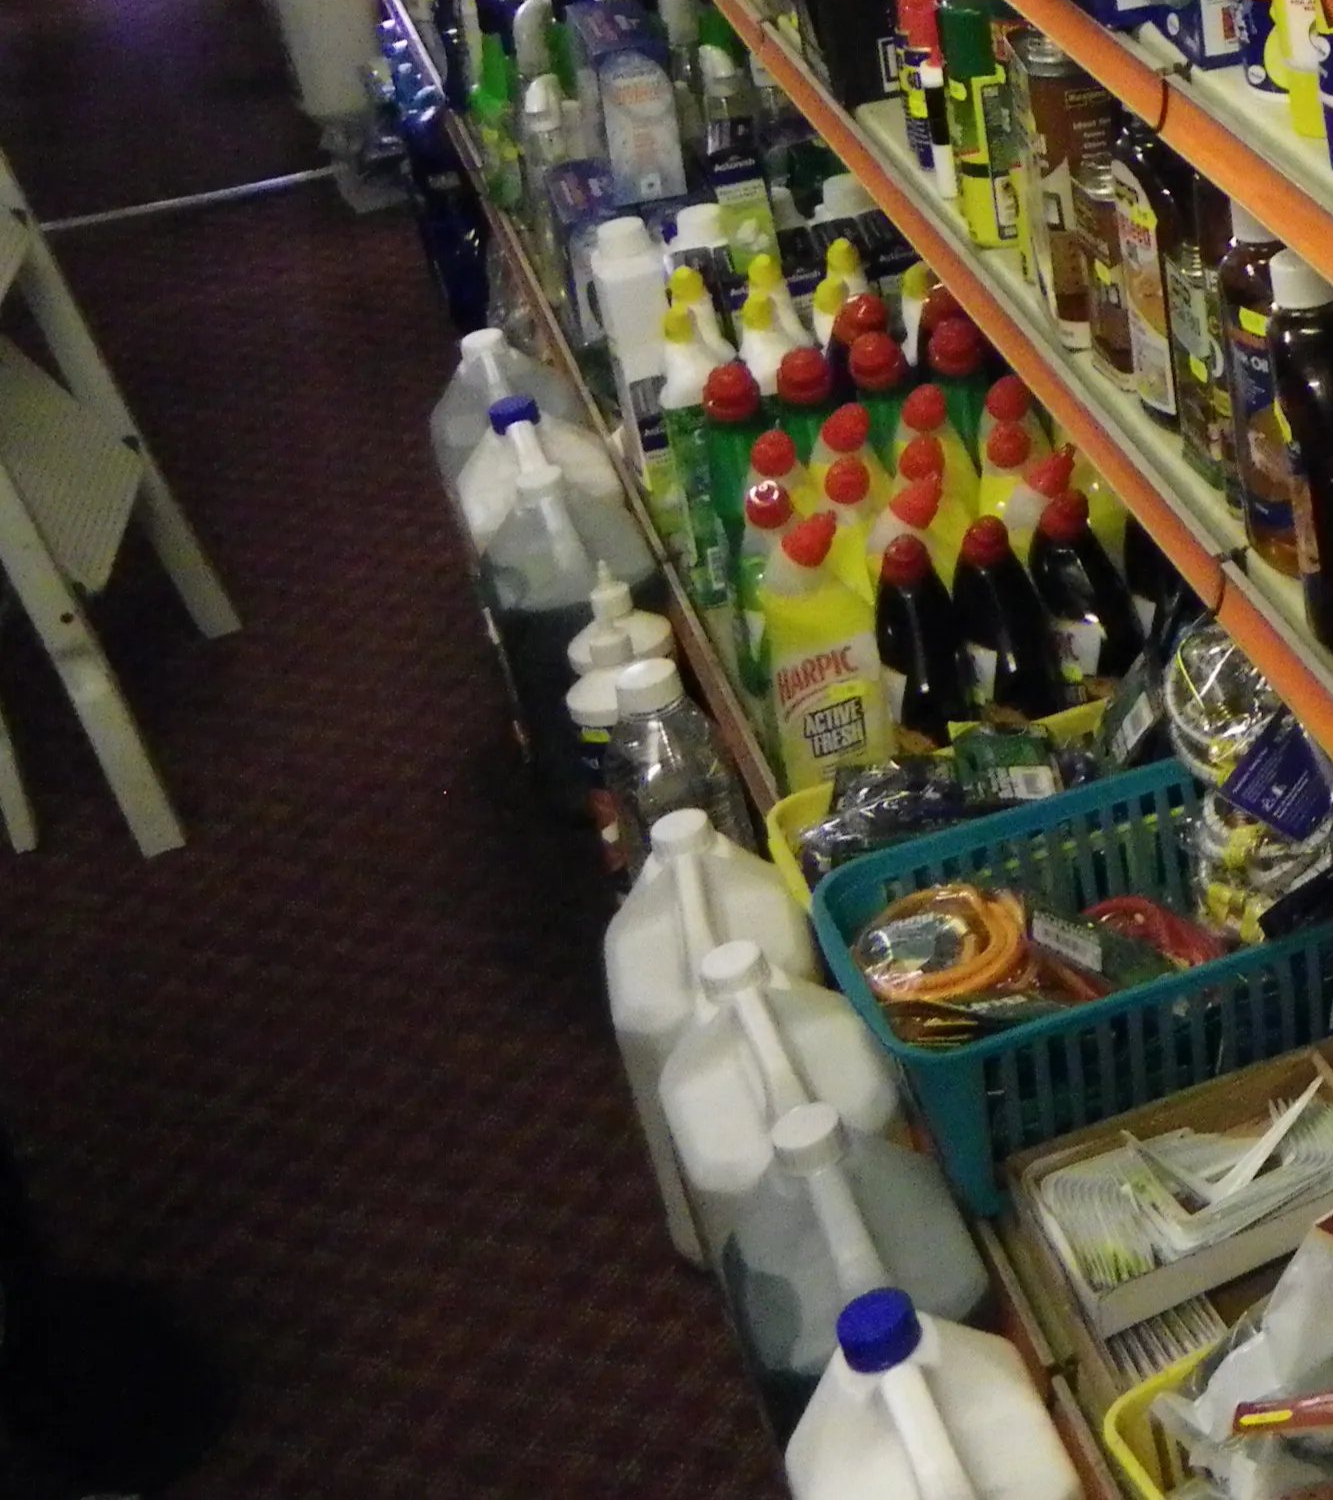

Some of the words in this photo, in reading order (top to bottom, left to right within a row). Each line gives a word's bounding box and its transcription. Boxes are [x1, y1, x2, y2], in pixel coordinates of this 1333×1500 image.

[777, 644, 859, 696] HARPIC
[804, 696, 863, 735] ACTIVE
[810, 721, 868, 758] FRESH
